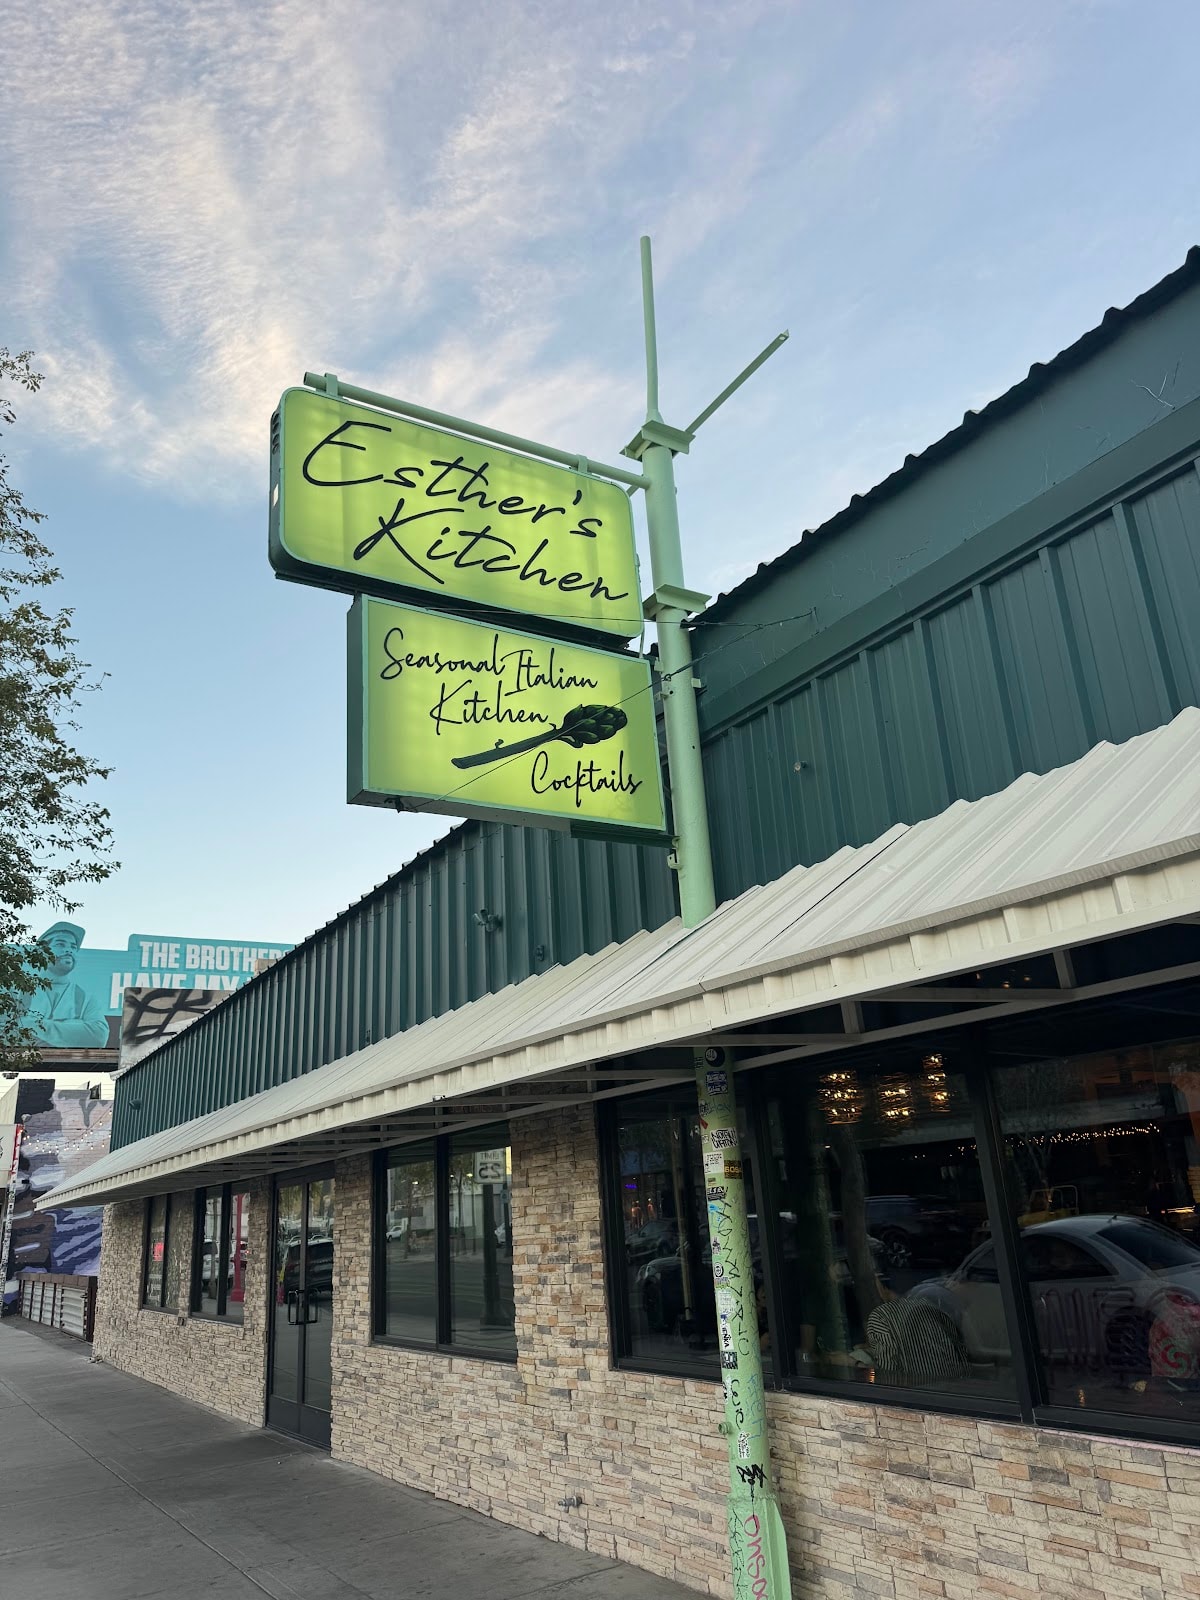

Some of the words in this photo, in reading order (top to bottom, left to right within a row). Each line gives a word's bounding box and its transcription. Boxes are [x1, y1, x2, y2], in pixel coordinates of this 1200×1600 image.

[302, 420, 603, 538] Esther's
[353, 498, 629, 600] Kitchen
[380, 627, 505, 680] Seasonal
[501, 647, 598, 696] Italian
[429, 680, 549, 735] Kitchen
[531, 750, 643, 807] Cocktails
[139, 941, 181, 969] THE
[185, 944, 291, 972] BROTH
